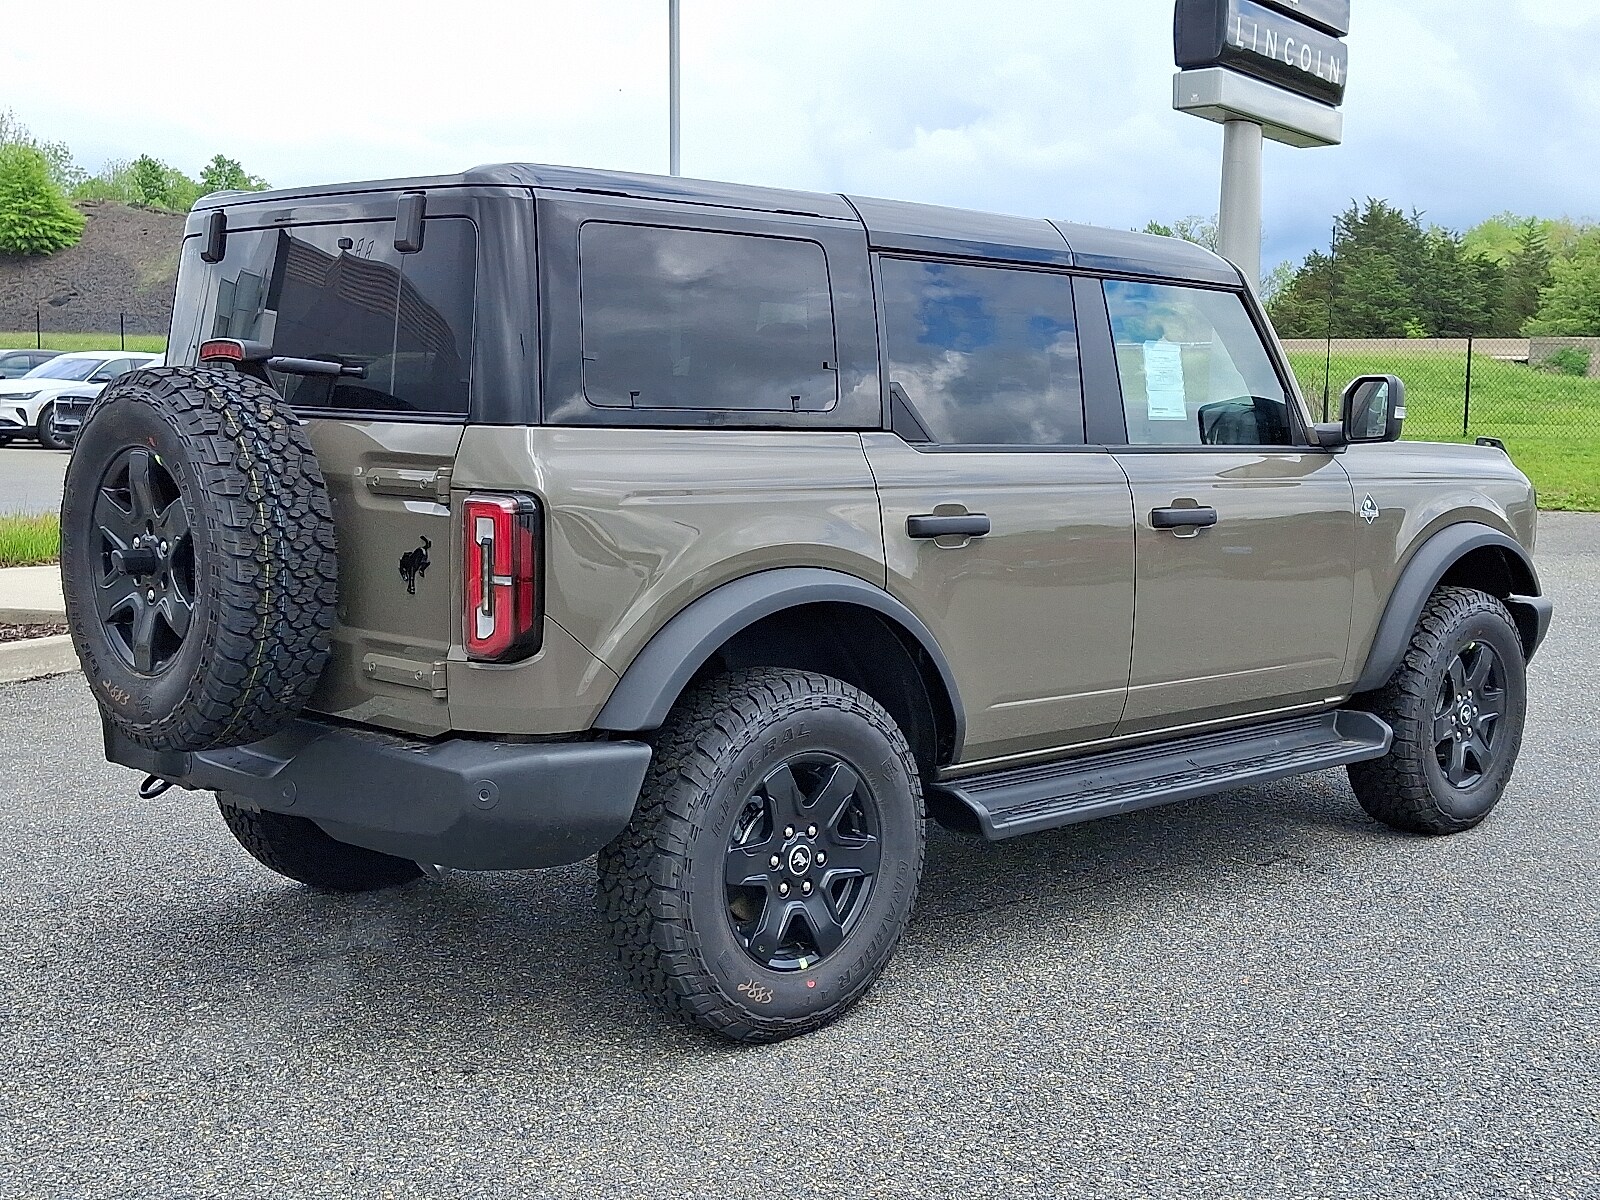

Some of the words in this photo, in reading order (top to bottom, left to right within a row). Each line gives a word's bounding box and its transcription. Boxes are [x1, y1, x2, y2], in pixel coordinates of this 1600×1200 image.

[1235, 16, 1340, 84] LINCOLN
[711, 721, 812, 838] GENERAL
[838, 860, 910, 990] GRABBER
